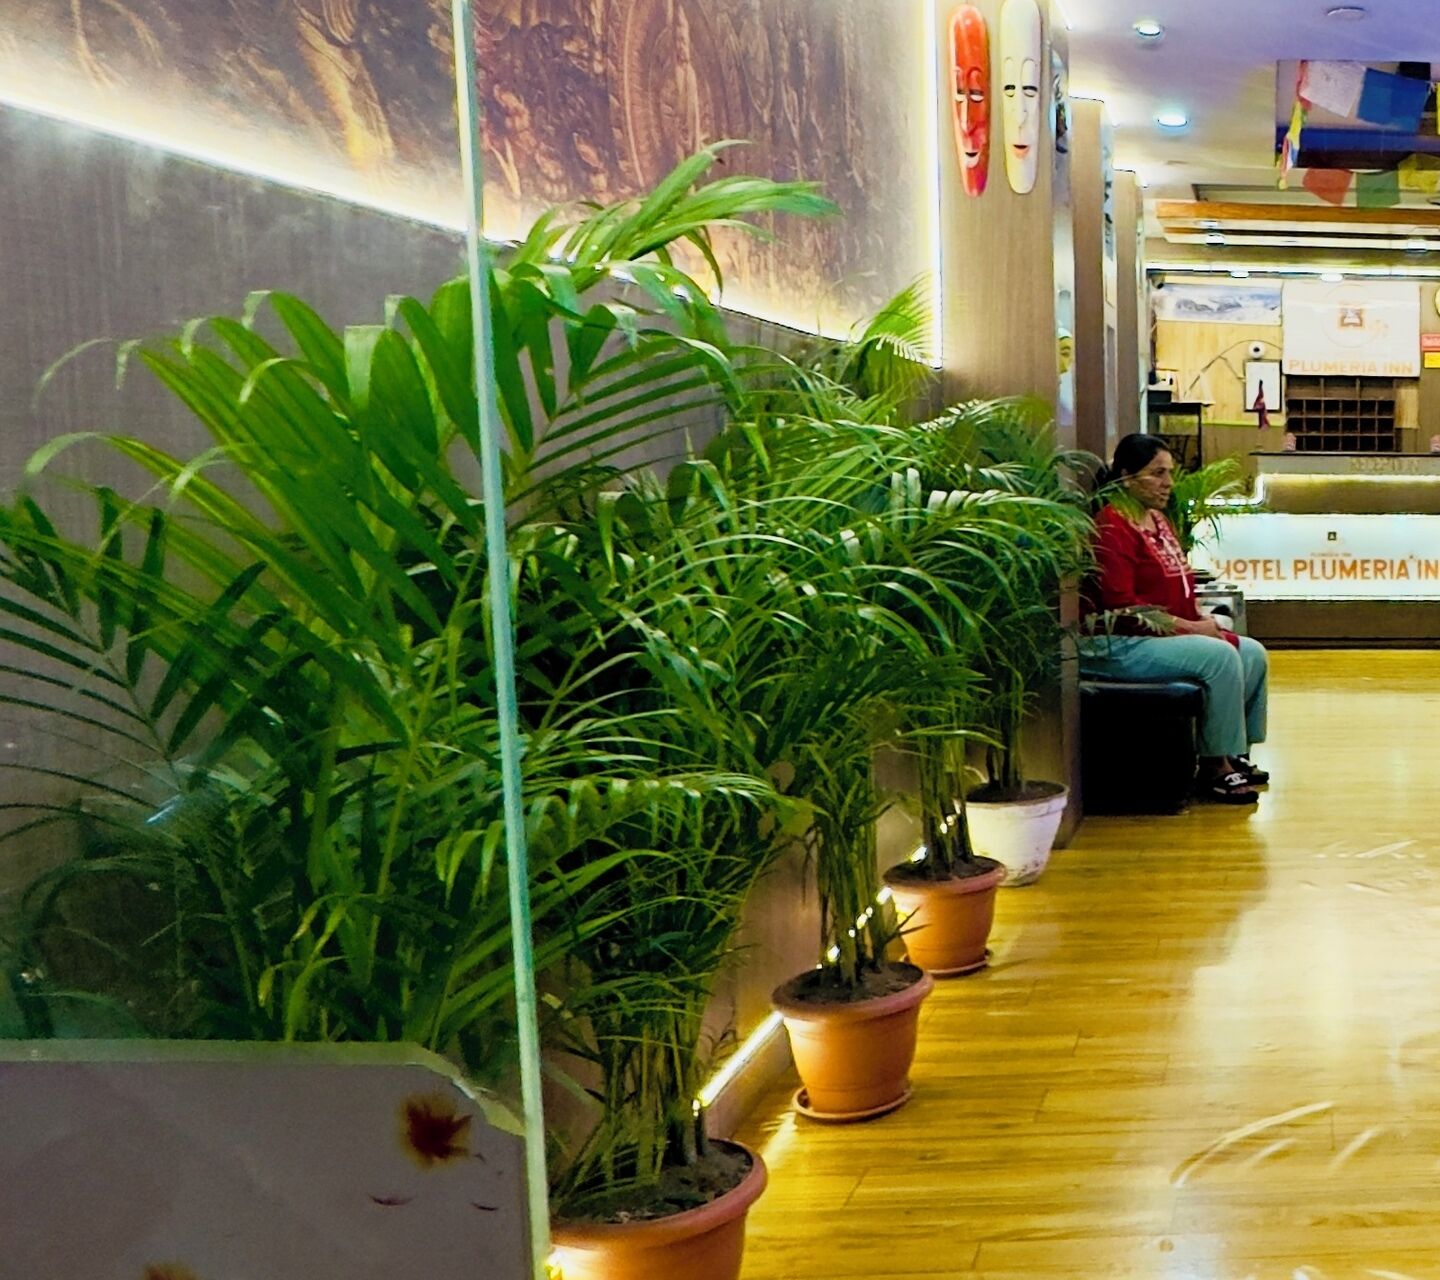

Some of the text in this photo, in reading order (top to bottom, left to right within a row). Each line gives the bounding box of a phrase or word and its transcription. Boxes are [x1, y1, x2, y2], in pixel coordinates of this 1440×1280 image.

[1288, 360, 1413, 374] PLUMERIA INN
[1293, 558, 1411, 581] PLUMERIA
